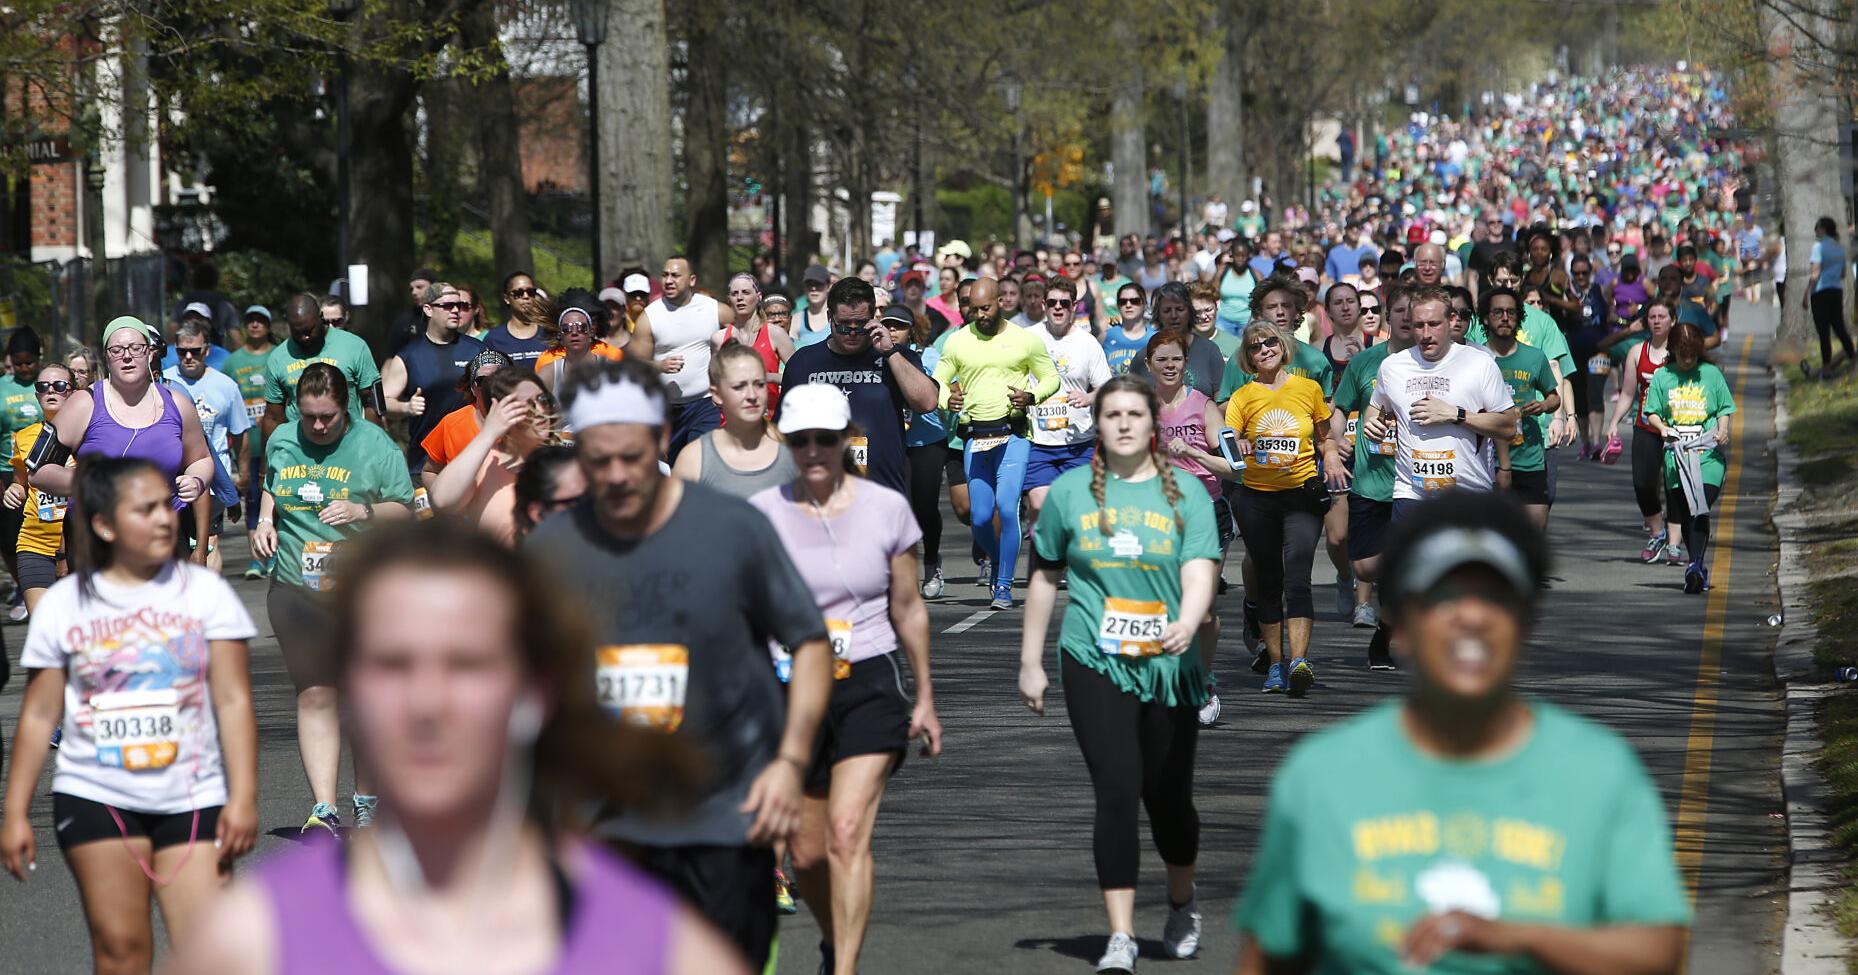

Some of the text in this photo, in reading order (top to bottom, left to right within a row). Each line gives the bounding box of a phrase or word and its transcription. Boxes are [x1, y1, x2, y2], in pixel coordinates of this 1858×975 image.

[808, 371, 882, 384] COWBOYS
[1406, 376, 1450, 392] ARKANSAS
[1037, 406, 1068, 417] 23308
[1160, 424, 1197, 437] PORTS
[1257, 439, 1296, 452] 35399
[280, 464, 351, 484] RVAS 10K!
[1413, 462, 1454, 475] 34198
[1080, 508, 1117, 531] RVS
[1106, 616, 1163, 638] 27625
[599, 673, 678, 702] 21731
[99, 716, 172, 739] 30338
